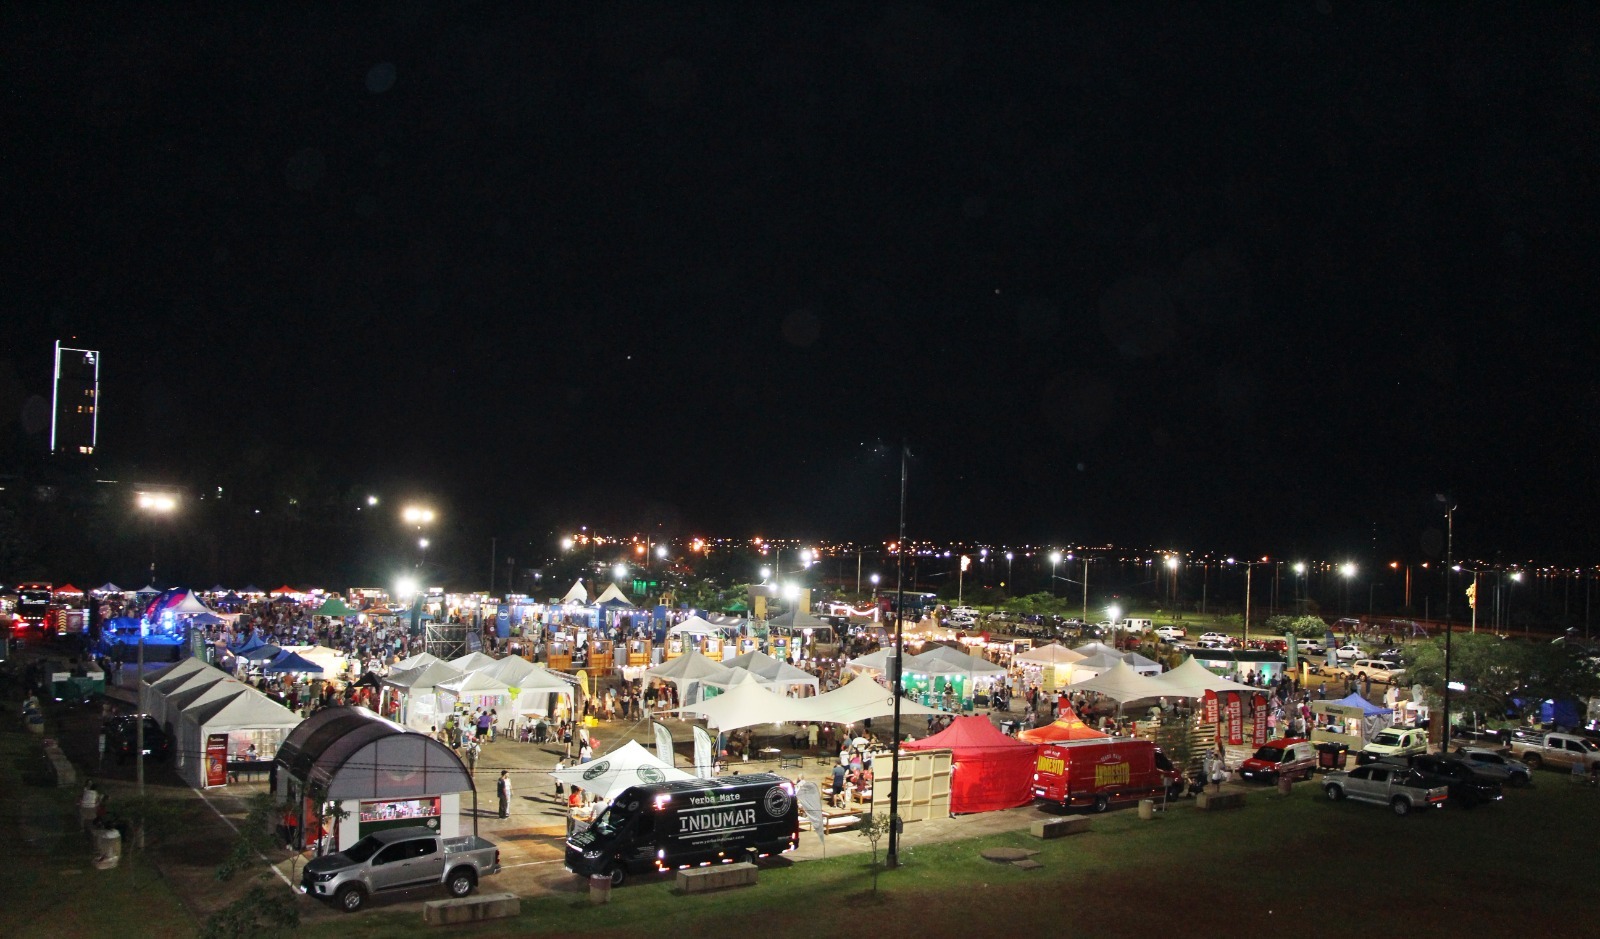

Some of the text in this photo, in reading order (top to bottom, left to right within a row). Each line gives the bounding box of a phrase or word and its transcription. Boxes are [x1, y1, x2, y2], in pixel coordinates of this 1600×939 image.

[1206, 699, 1218, 723] anda
[1229, 701, 1241, 740] amanda
[1255, 705, 1267, 744] amanda
[690, 793, 741, 805] Yerba Mate
[679, 808, 756, 833] INDUMAR
